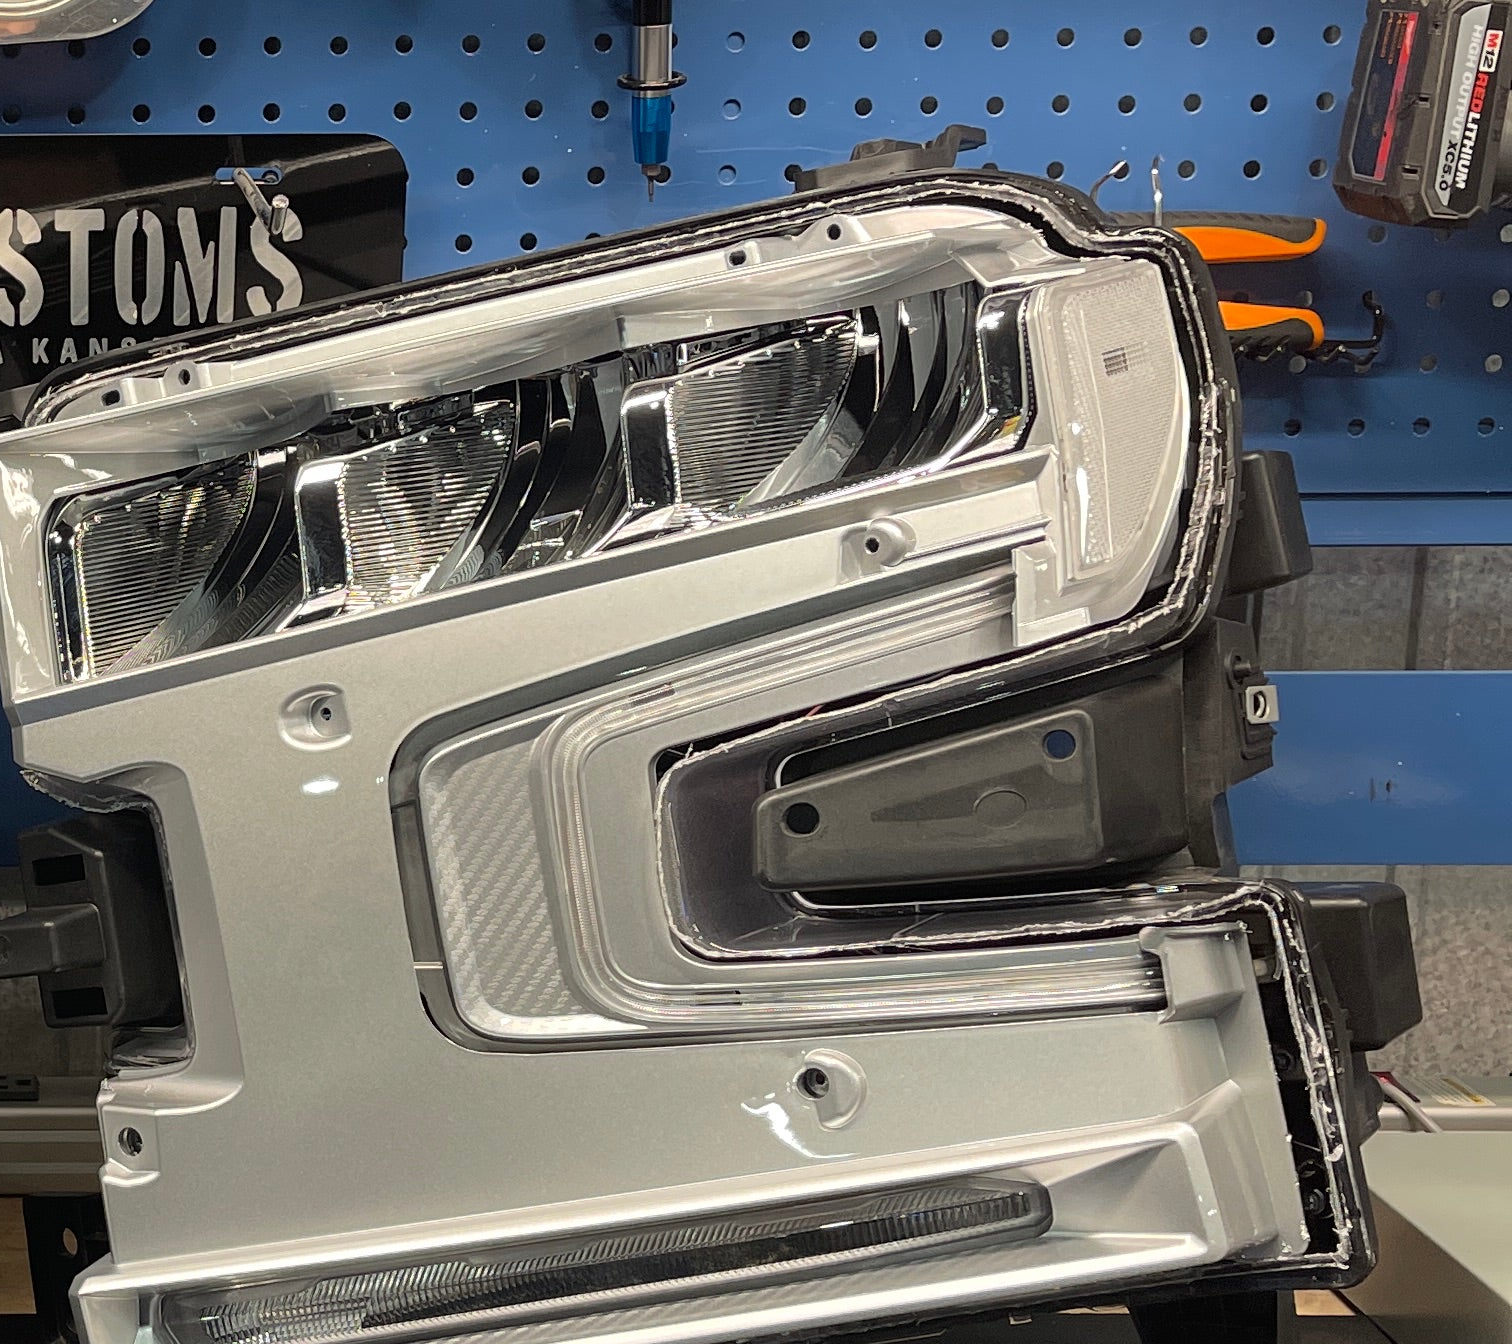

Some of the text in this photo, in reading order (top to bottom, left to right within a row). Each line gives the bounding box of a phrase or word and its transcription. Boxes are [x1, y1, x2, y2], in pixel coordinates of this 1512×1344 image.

[1484, 33, 1501, 70] M12
[1439, 24, 1484, 191] HIGH OUTPUT XC5.0
